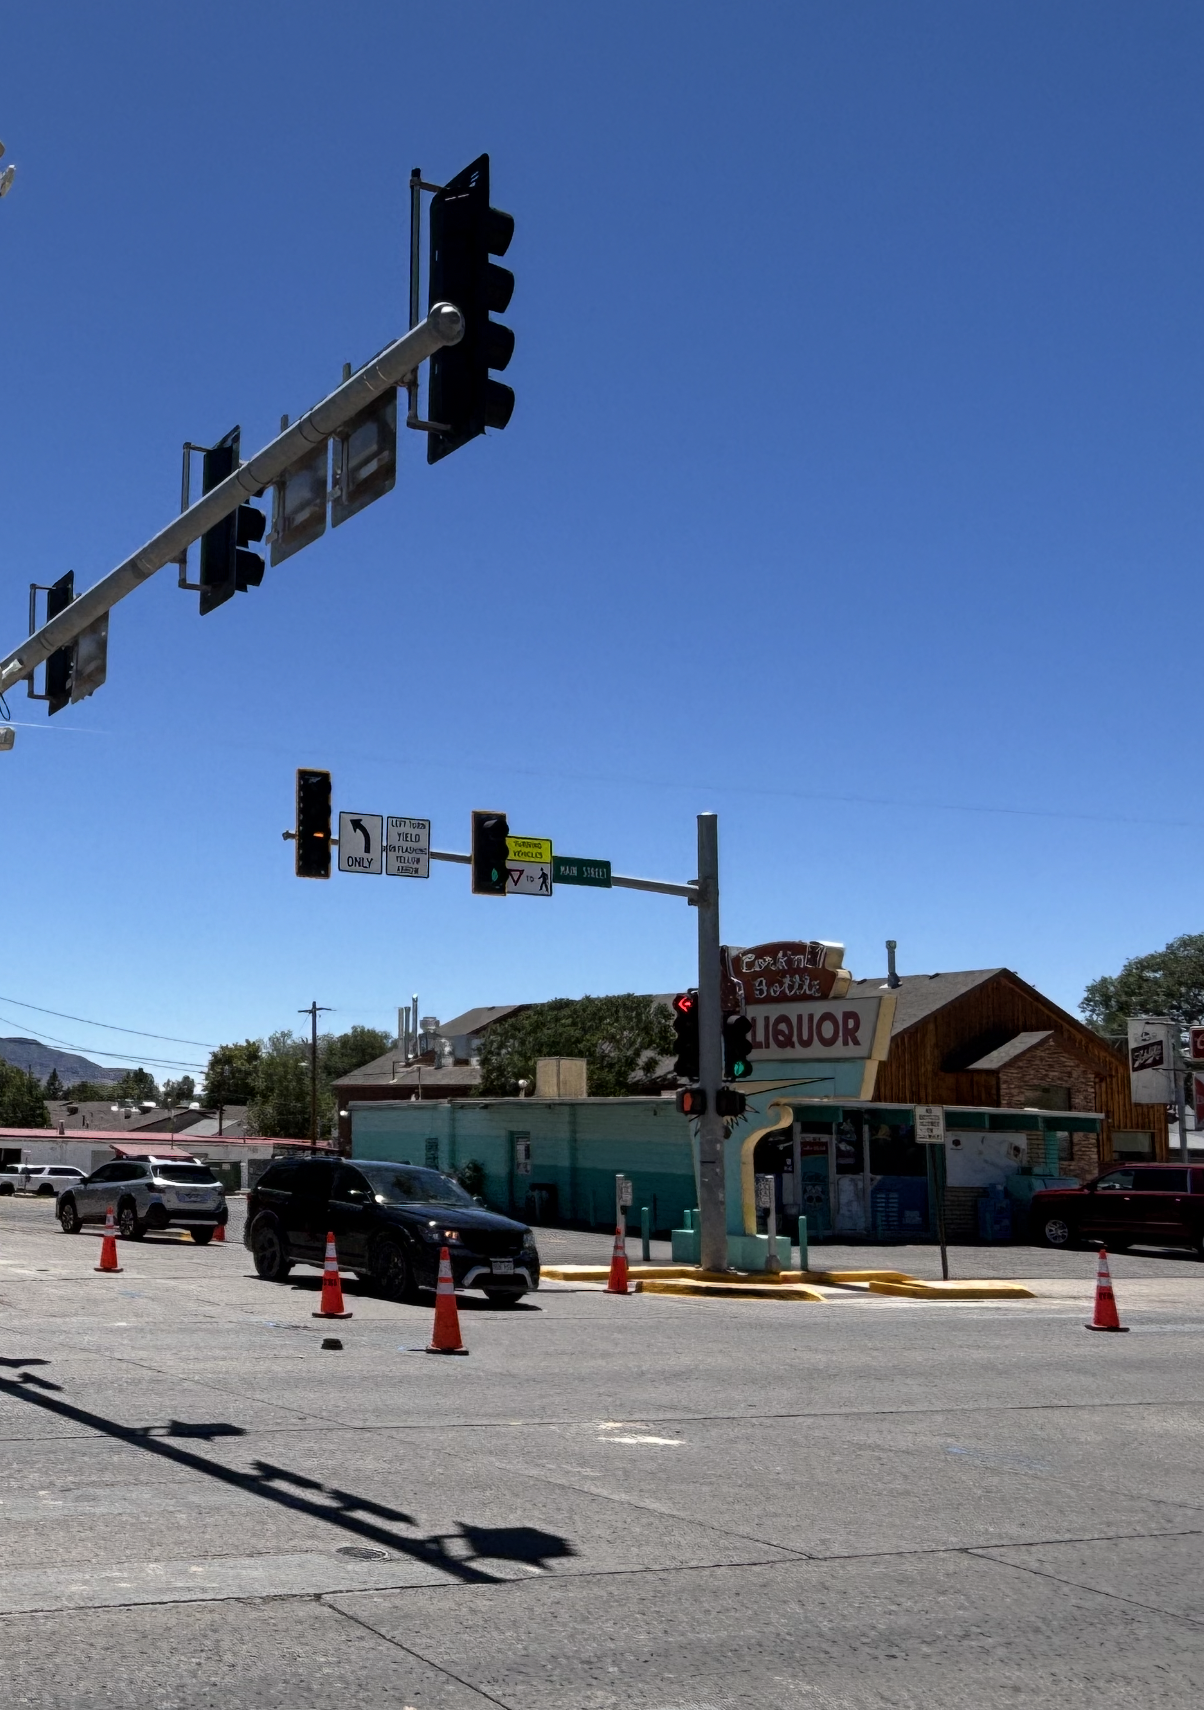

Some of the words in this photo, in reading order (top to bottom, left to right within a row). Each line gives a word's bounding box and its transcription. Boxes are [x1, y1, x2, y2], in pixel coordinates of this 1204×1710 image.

[397, 832, 421, 843] YIELD
[347, 856, 374, 869] ONLY
[583, 867, 607, 878] STREET
[526, 875, 535, 883] TO
[750, 1010, 862, 1049] LIQUOR
